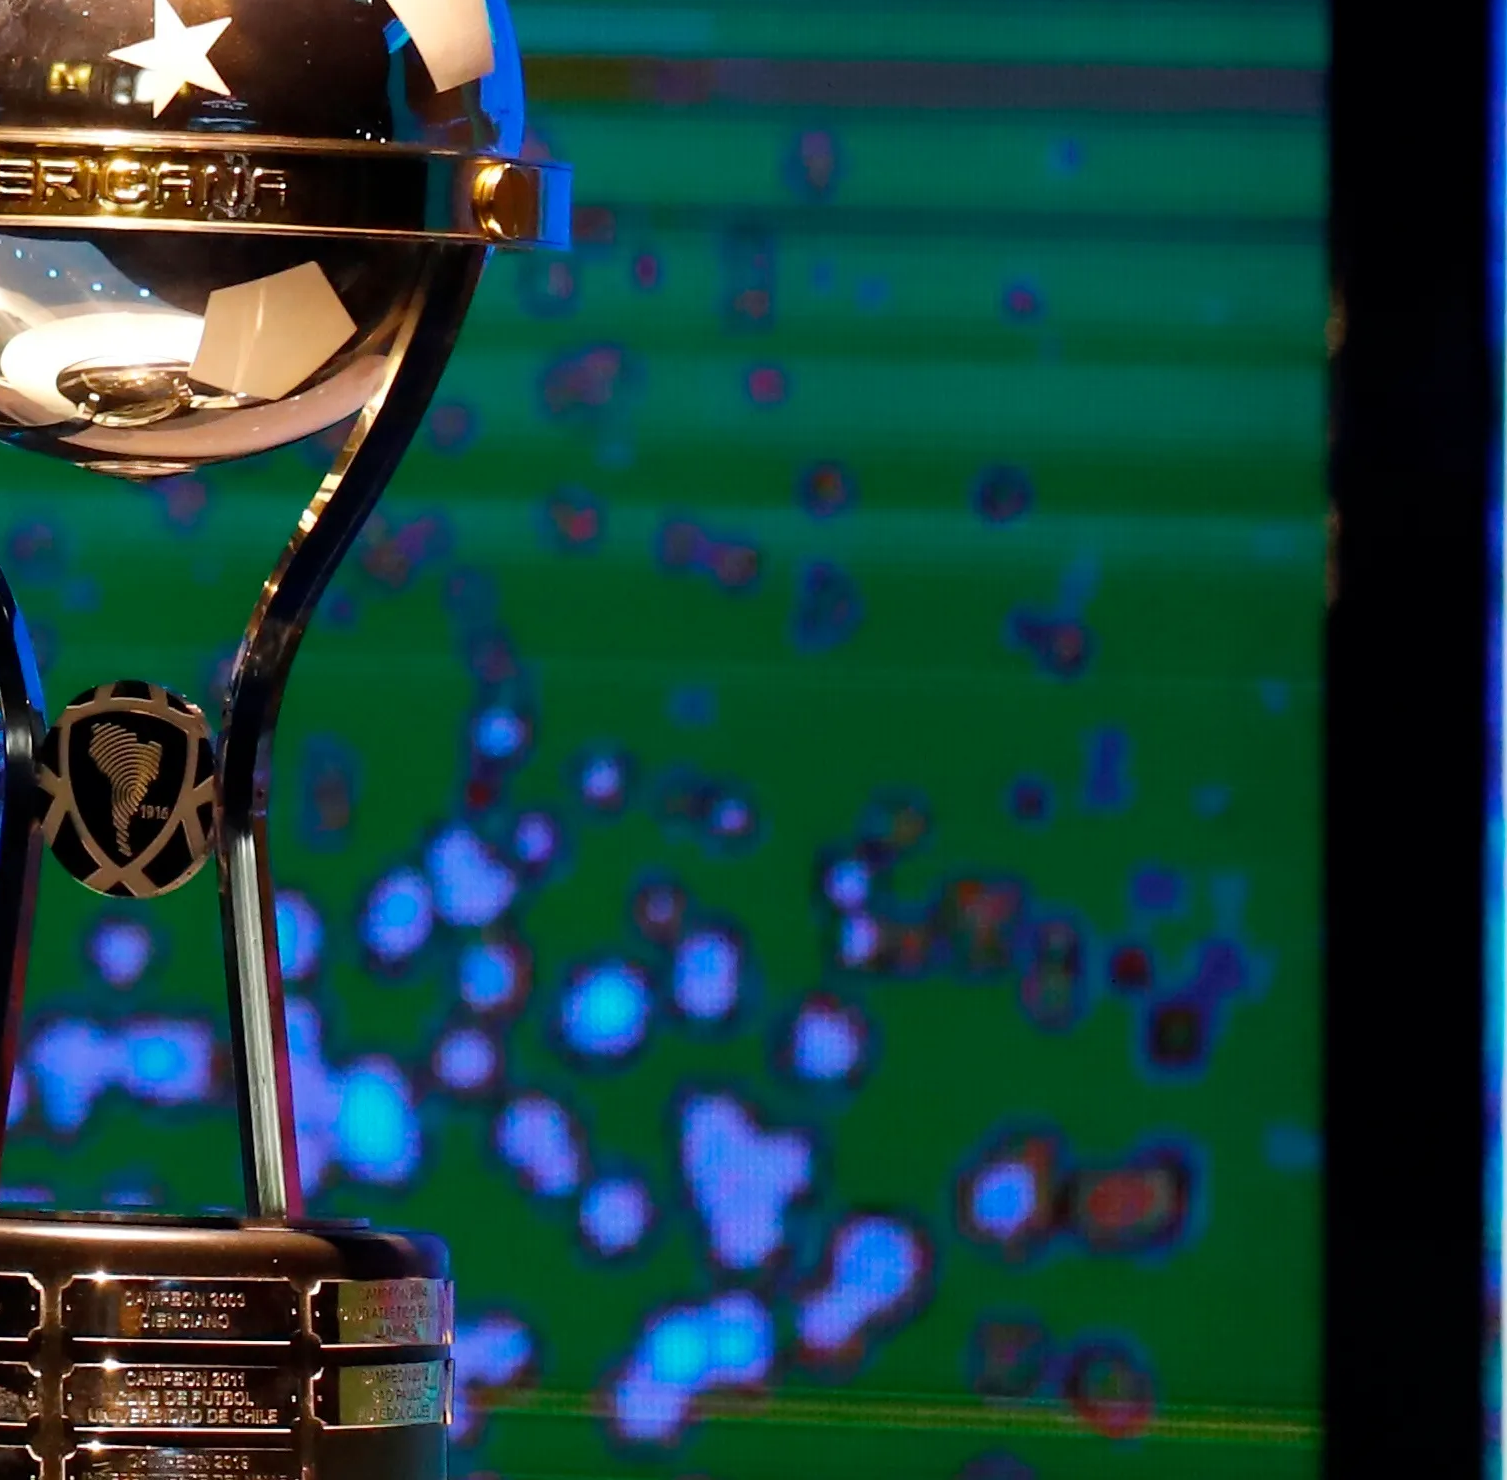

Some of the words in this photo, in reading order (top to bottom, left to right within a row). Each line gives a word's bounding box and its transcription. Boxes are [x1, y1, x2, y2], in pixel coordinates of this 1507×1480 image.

[123, 1370, 208, 1387] CAMPEON
[211, 1371, 246, 1387] 2011
[165, 1390, 188, 1406] DE
[191, 1390, 255, 1407] FUTBOL
[206, 1408, 229, 1424] DE
[232, 1408, 278, 1425] CHILE
